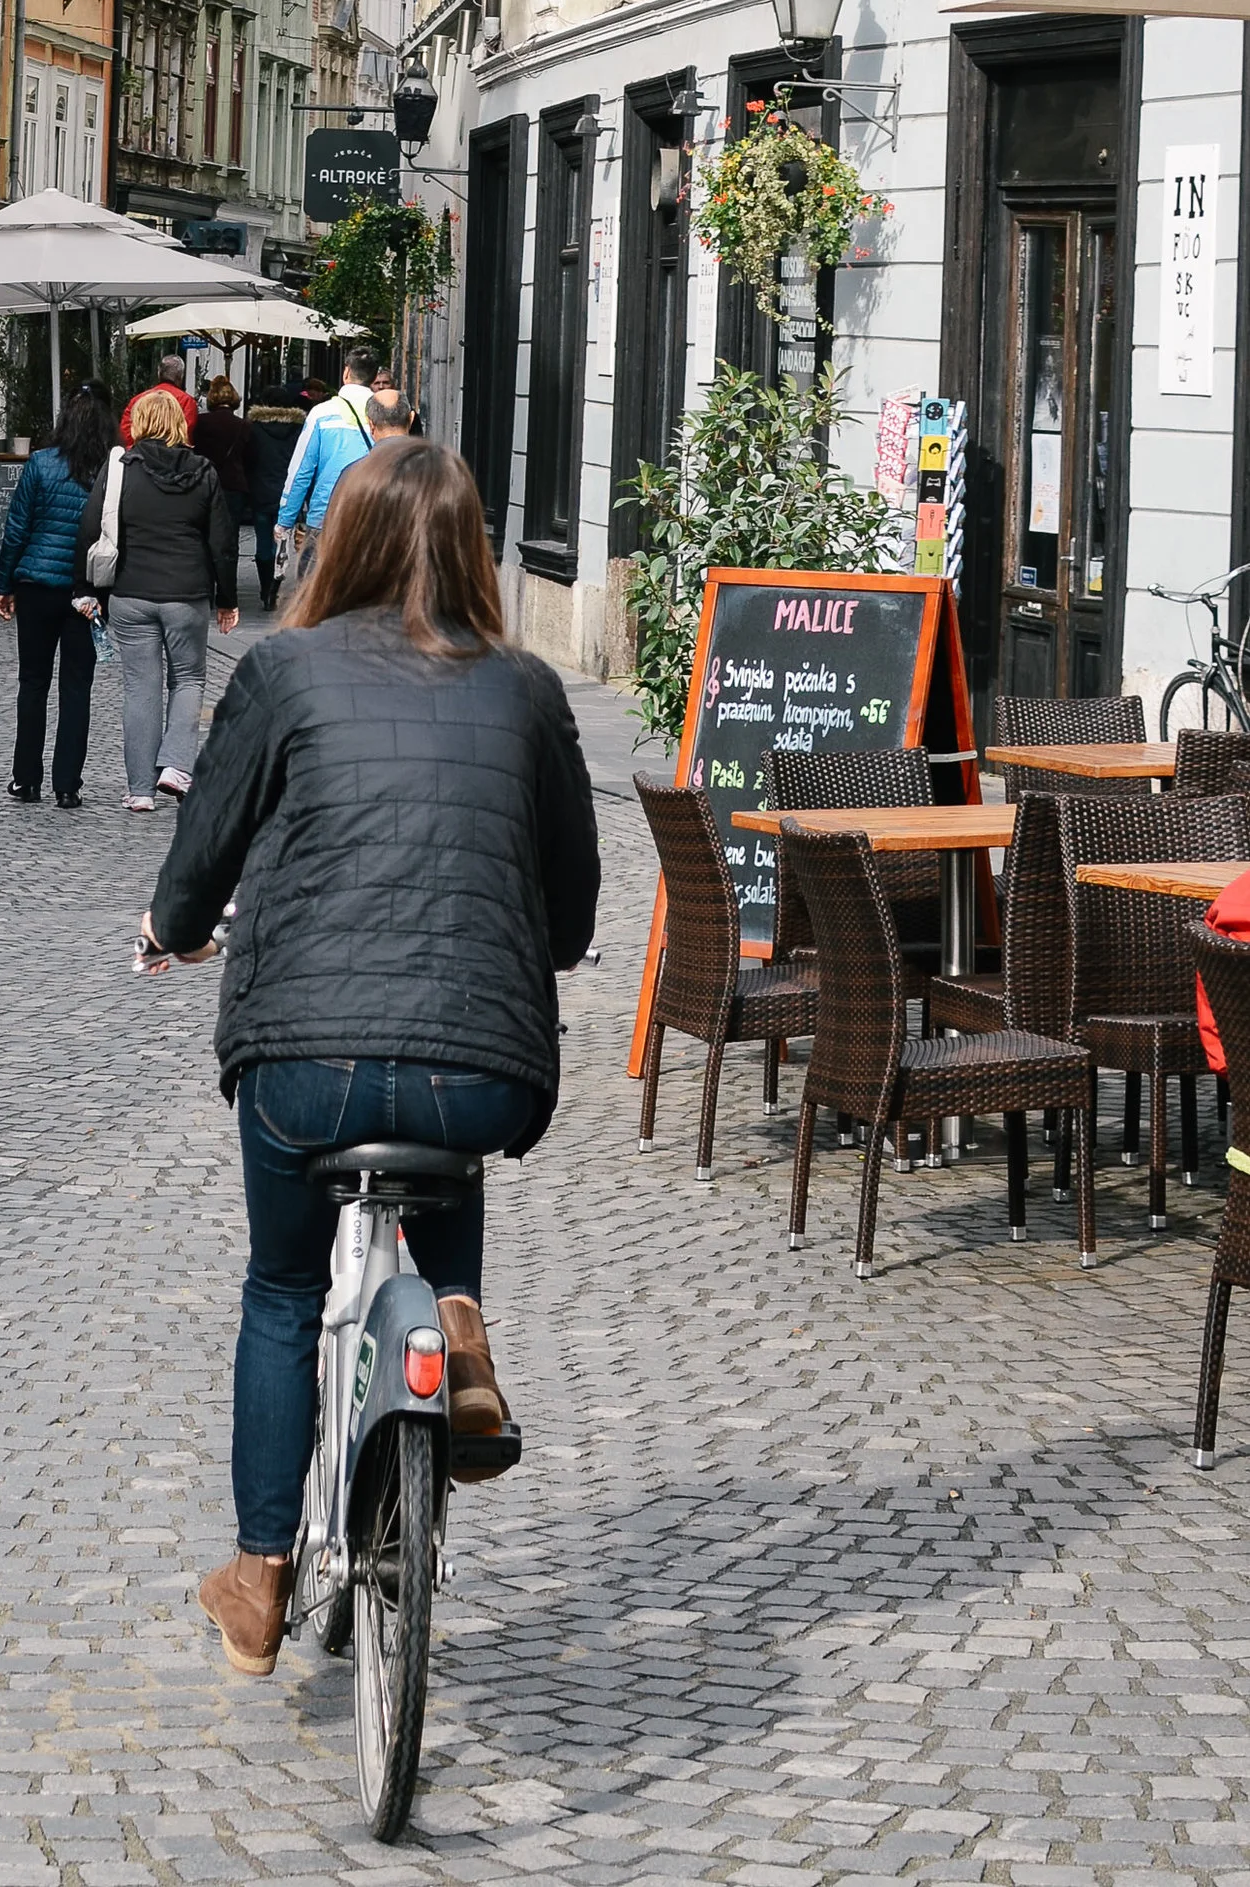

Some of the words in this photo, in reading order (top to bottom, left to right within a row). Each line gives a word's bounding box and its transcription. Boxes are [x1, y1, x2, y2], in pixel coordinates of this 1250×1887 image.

[319, 166, 387, 185] ALTROKÈ
[1173, 174, 1206, 219] IN
[773, 598, 860, 635] MALICE
[723, 658, 775, 701] Svinjska
[783, 661, 837, 701] pečenka
[845, 673, 856, 694] s
[773, 726, 814, 753] solata
[710, 759, 745, 790] Pašta
